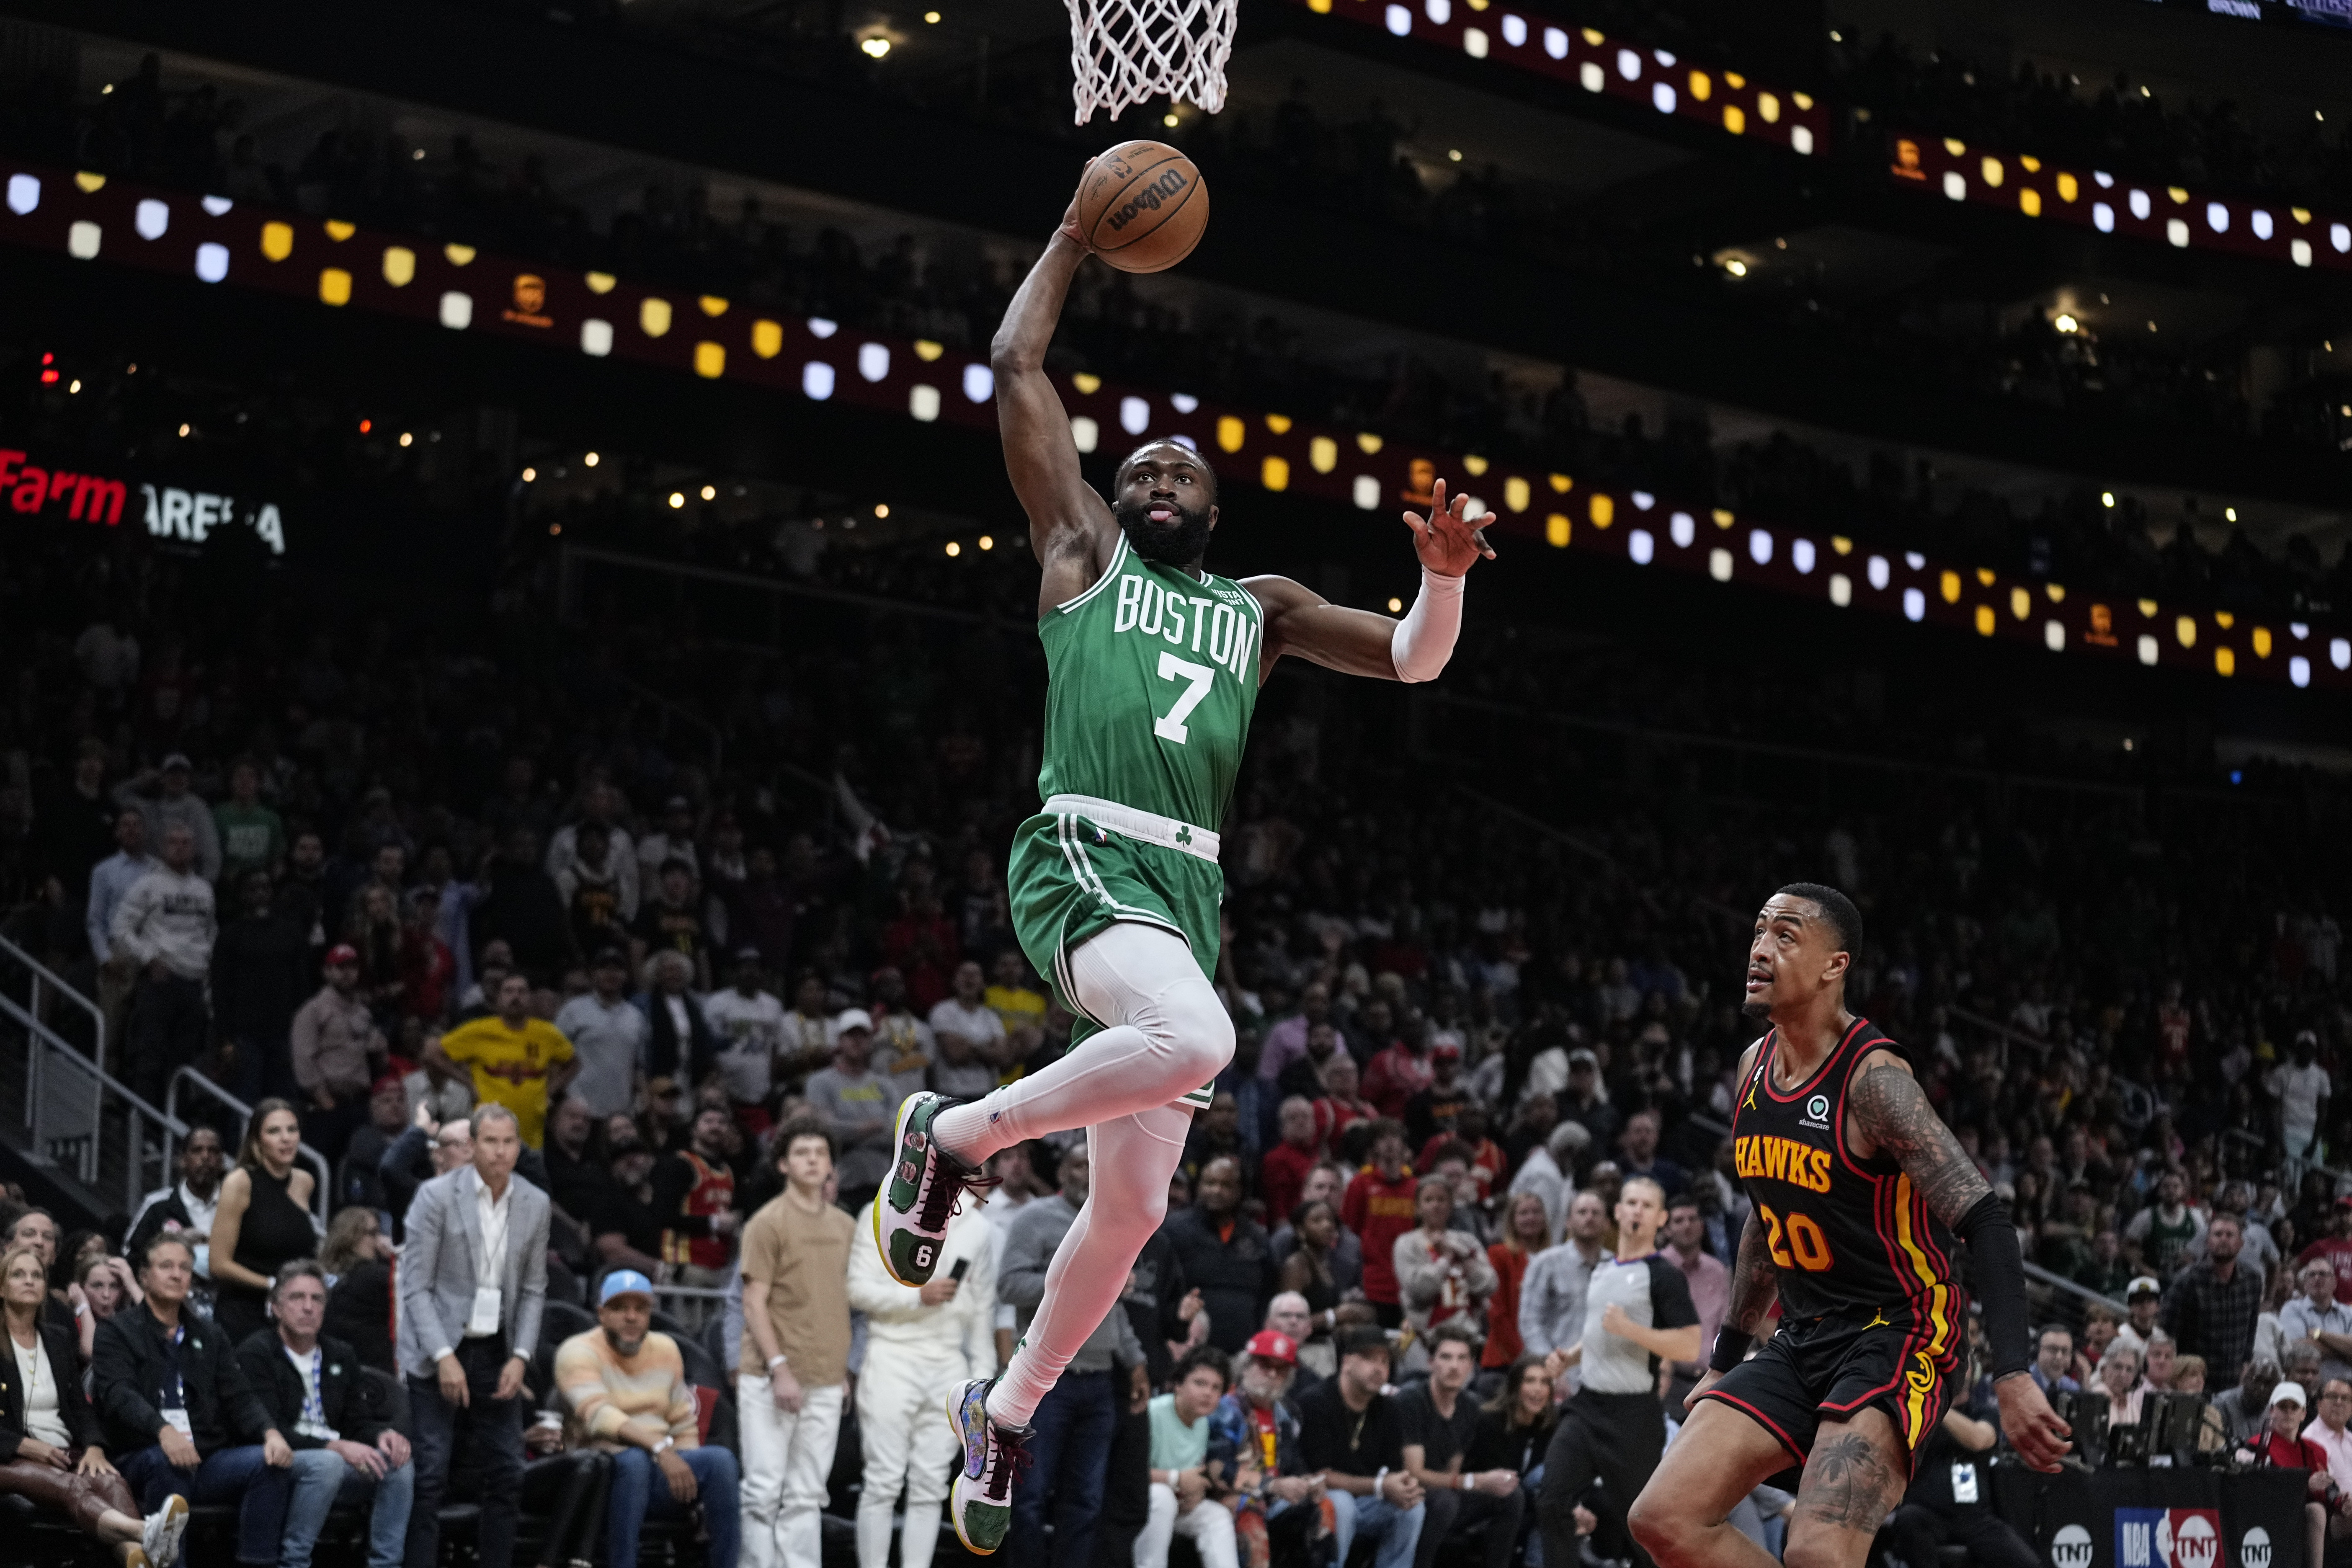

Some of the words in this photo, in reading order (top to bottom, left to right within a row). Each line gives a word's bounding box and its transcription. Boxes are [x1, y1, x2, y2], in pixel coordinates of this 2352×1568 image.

[1106, 168, 1189, 231] Wilson
[0, 448, 127, 526] Farm
[1211, 588, 1242, 599] VISTA
[1114, 574, 1256, 685] BOSTON
[1154, 651, 1215, 745] 7
[1754, 1065, 1764, 1081] 6
[1799, 1118, 1830, 1130] sharecare
[1735, 1134, 1832, 1194] HAWKS
[1760, 1202, 1834, 1271] 20
[916, 1245, 933, 1267] 6
[2053, 1543, 2093, 1562] TNT
[2122, 1522, 2150, 1567] NBA
[2177, 1537, 2218, 1559] TNT
[2241, 1545, 2272, 1563] TNT
